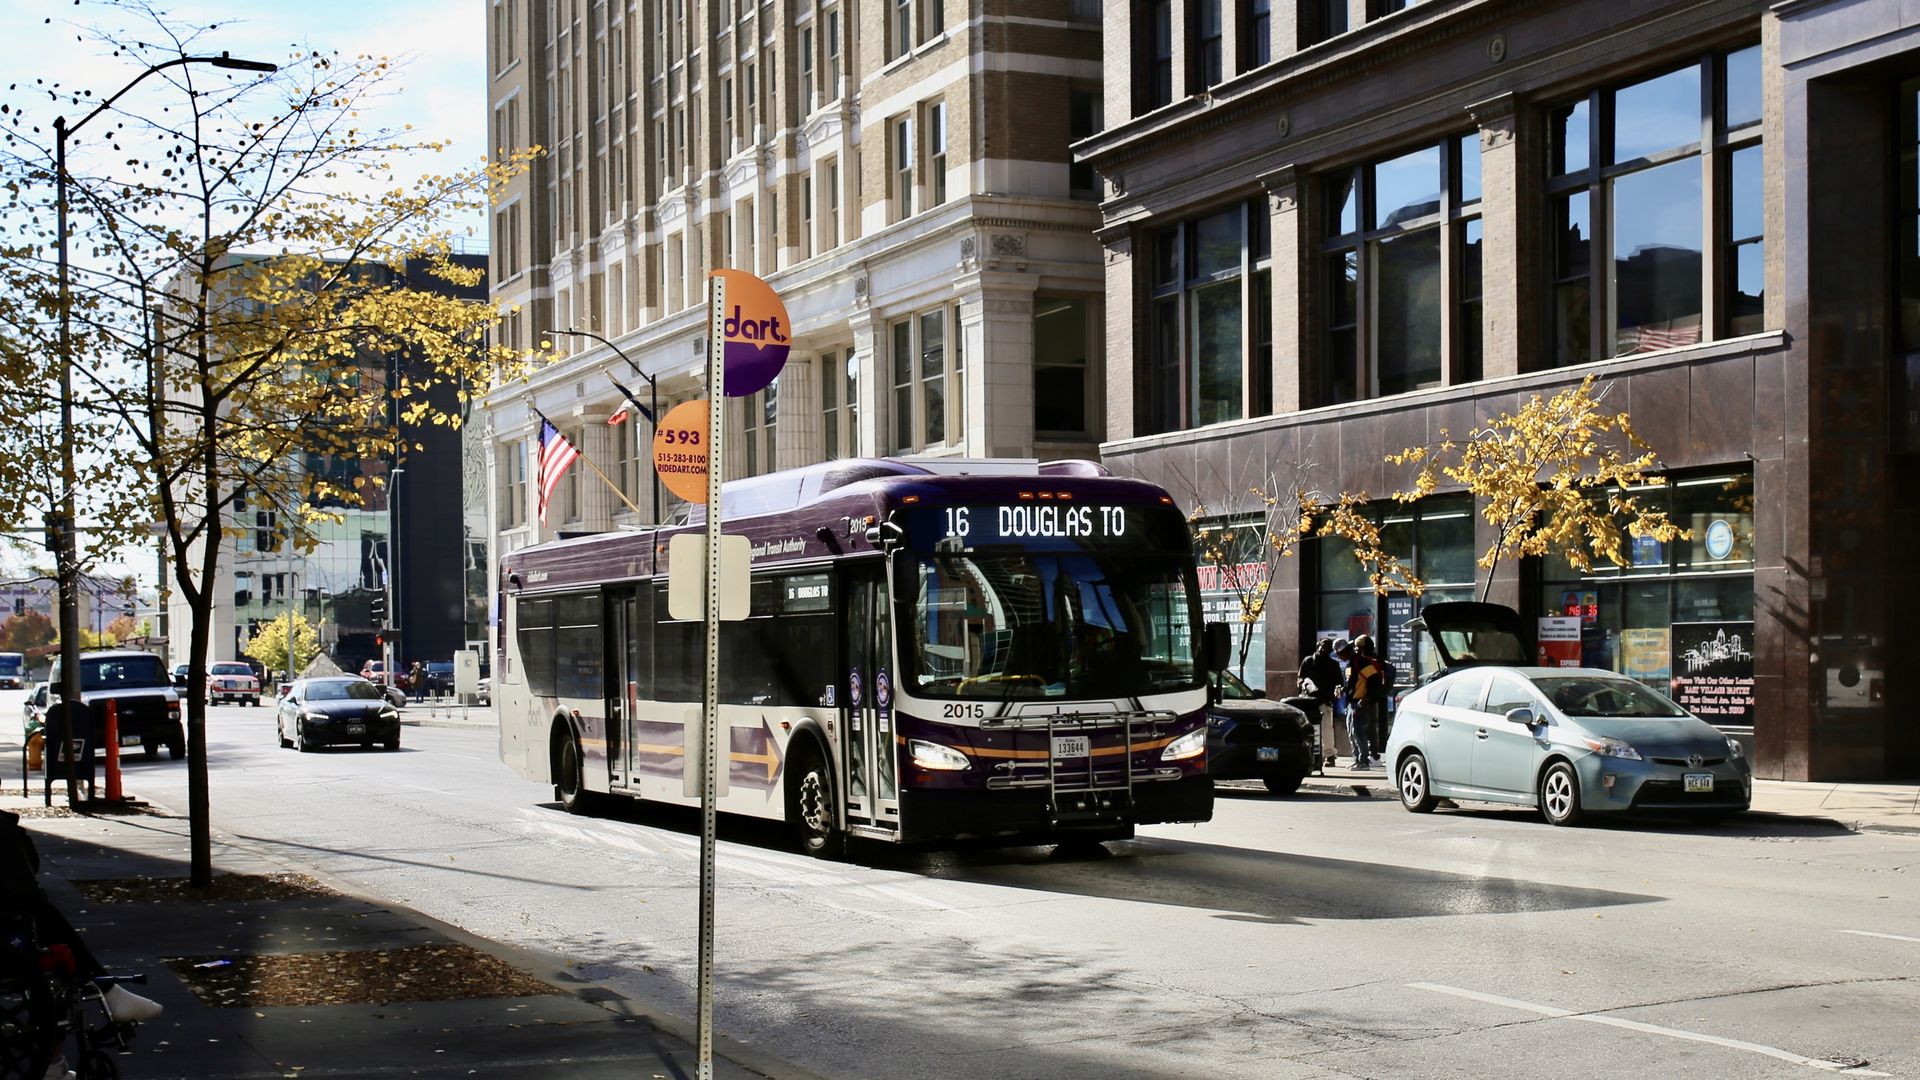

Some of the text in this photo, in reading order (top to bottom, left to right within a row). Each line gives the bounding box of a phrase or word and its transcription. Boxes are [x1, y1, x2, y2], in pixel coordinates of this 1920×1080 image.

[724, 305, 781, 342] dart
[658, 453, 706, 464] 515-283-8100
[657, 464, 707, 475] RIDEDART.COM
[850, 518, 867, 533] 2015
[945, 506, 1125, 537] 16 DOUGLAS TO
[750, 536, 806, 561] gional Transit Authority
[1700, 686, 1725, 695] VILLAGE
[943, 703, 984, 719] 2015
[1058, 742, 1084, 753] 133644
